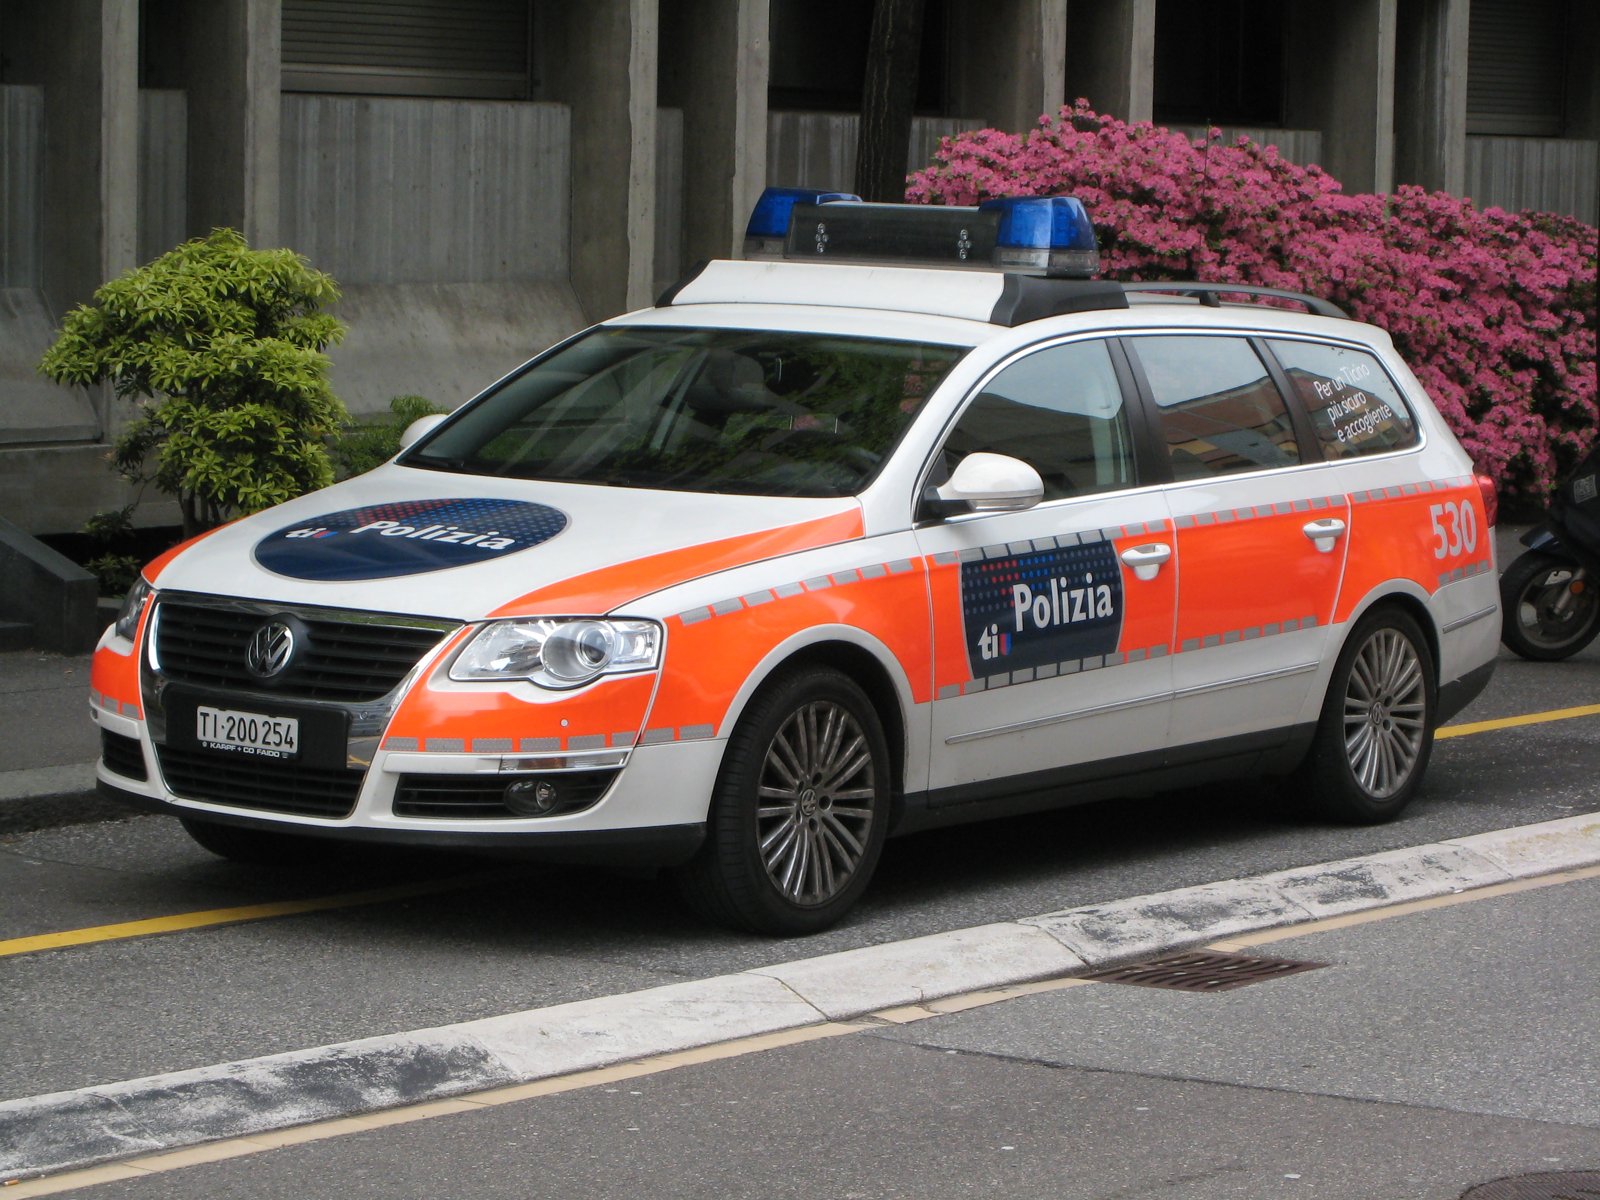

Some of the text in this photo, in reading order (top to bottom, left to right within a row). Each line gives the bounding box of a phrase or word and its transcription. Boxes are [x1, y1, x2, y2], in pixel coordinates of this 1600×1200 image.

[1313, 363, 1370, 400] Per un Ticino
[1341, 391, 1367, 414] sicuro
[1337, 404, 1392, 443] e accogliente
[350, 520, 515, 550] Polizia
[1429, 499, 1477, 560] 530
[1012, 572, 1114, 632] Polizia
[977, 624, 999, 660] ti
[243, 746, 255, 754] CO
[256, 748, 280, 758] FAIDO
